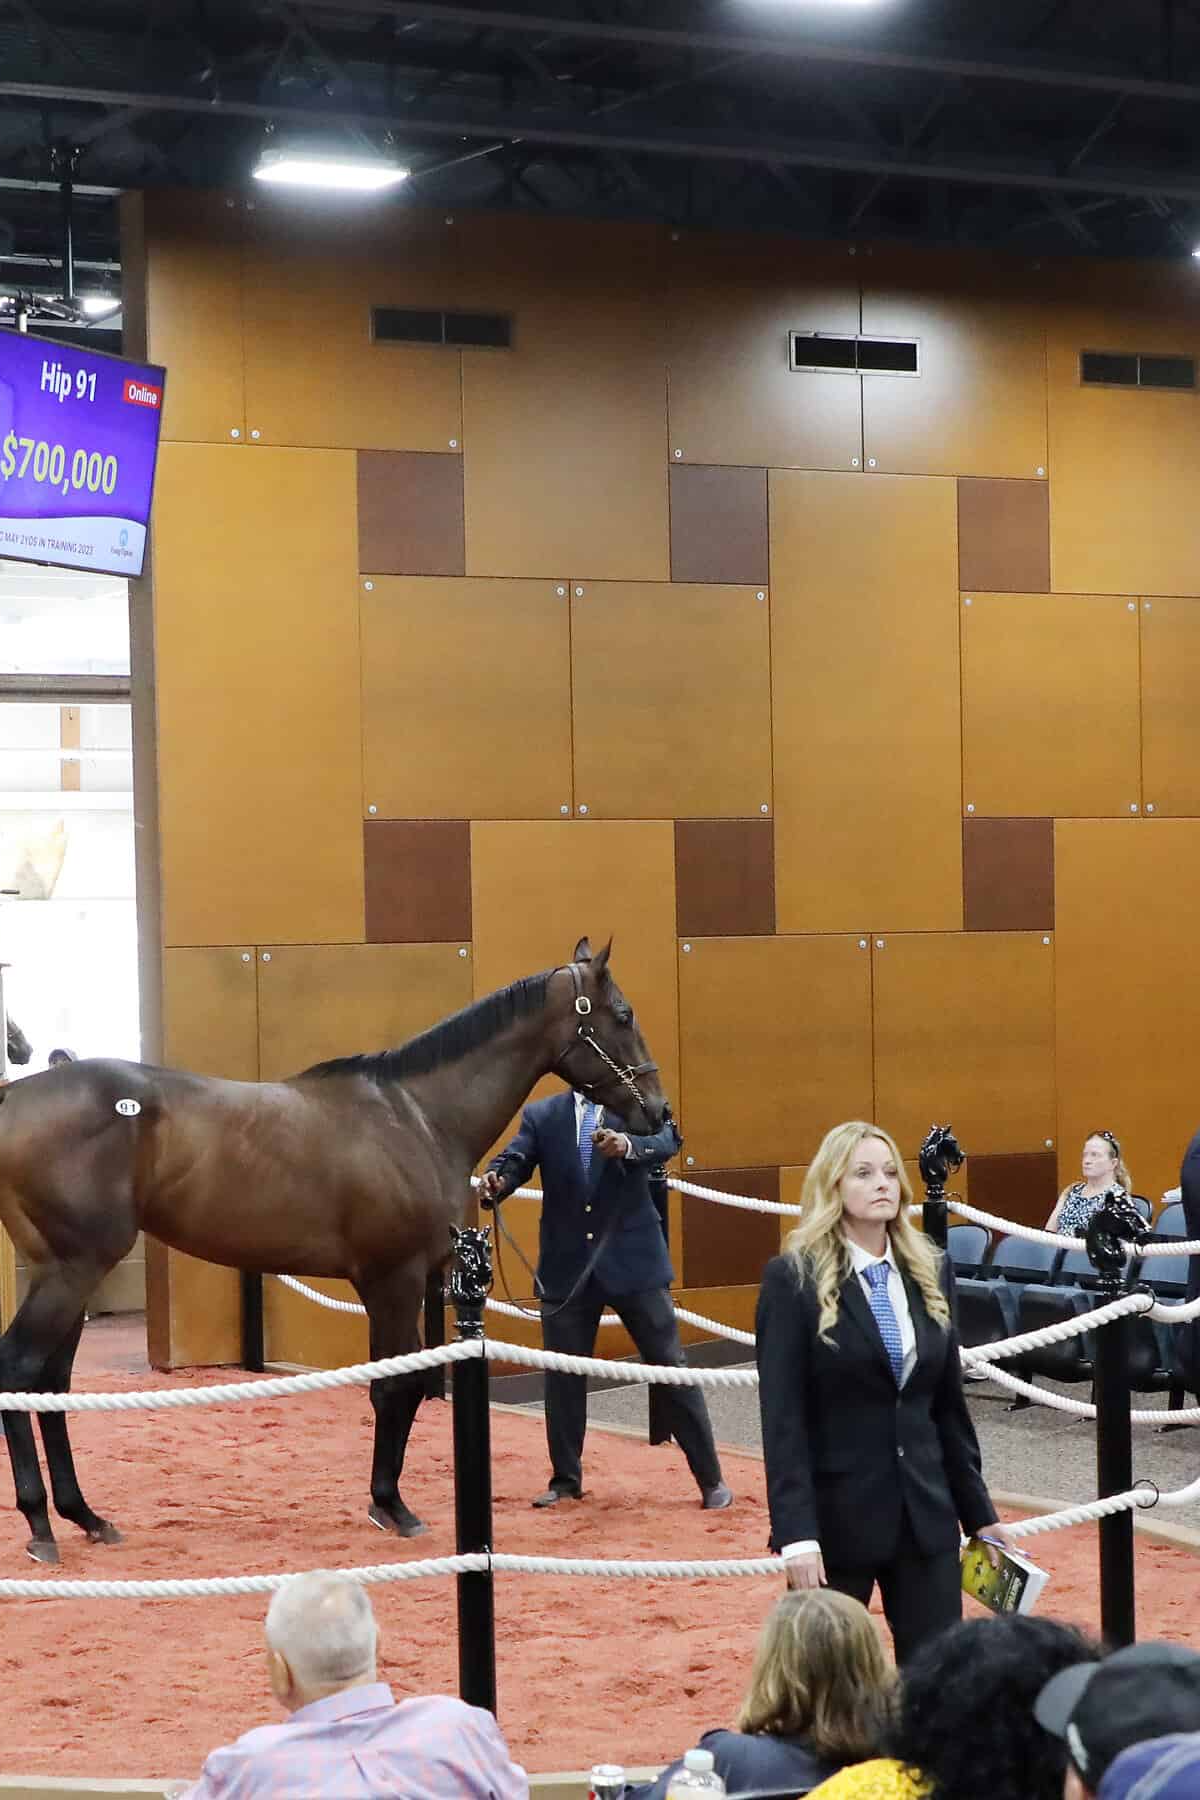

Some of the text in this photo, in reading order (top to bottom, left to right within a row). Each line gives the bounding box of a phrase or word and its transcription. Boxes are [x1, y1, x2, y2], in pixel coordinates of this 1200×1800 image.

[40, 360, 97, 403] Hip 91
[128, 384, 158, 405] Online
[0, 429, 118, 496] $700,000
[47, 538, 77, 553] TRAINING
[120, 1102, 136, 1113] 91
